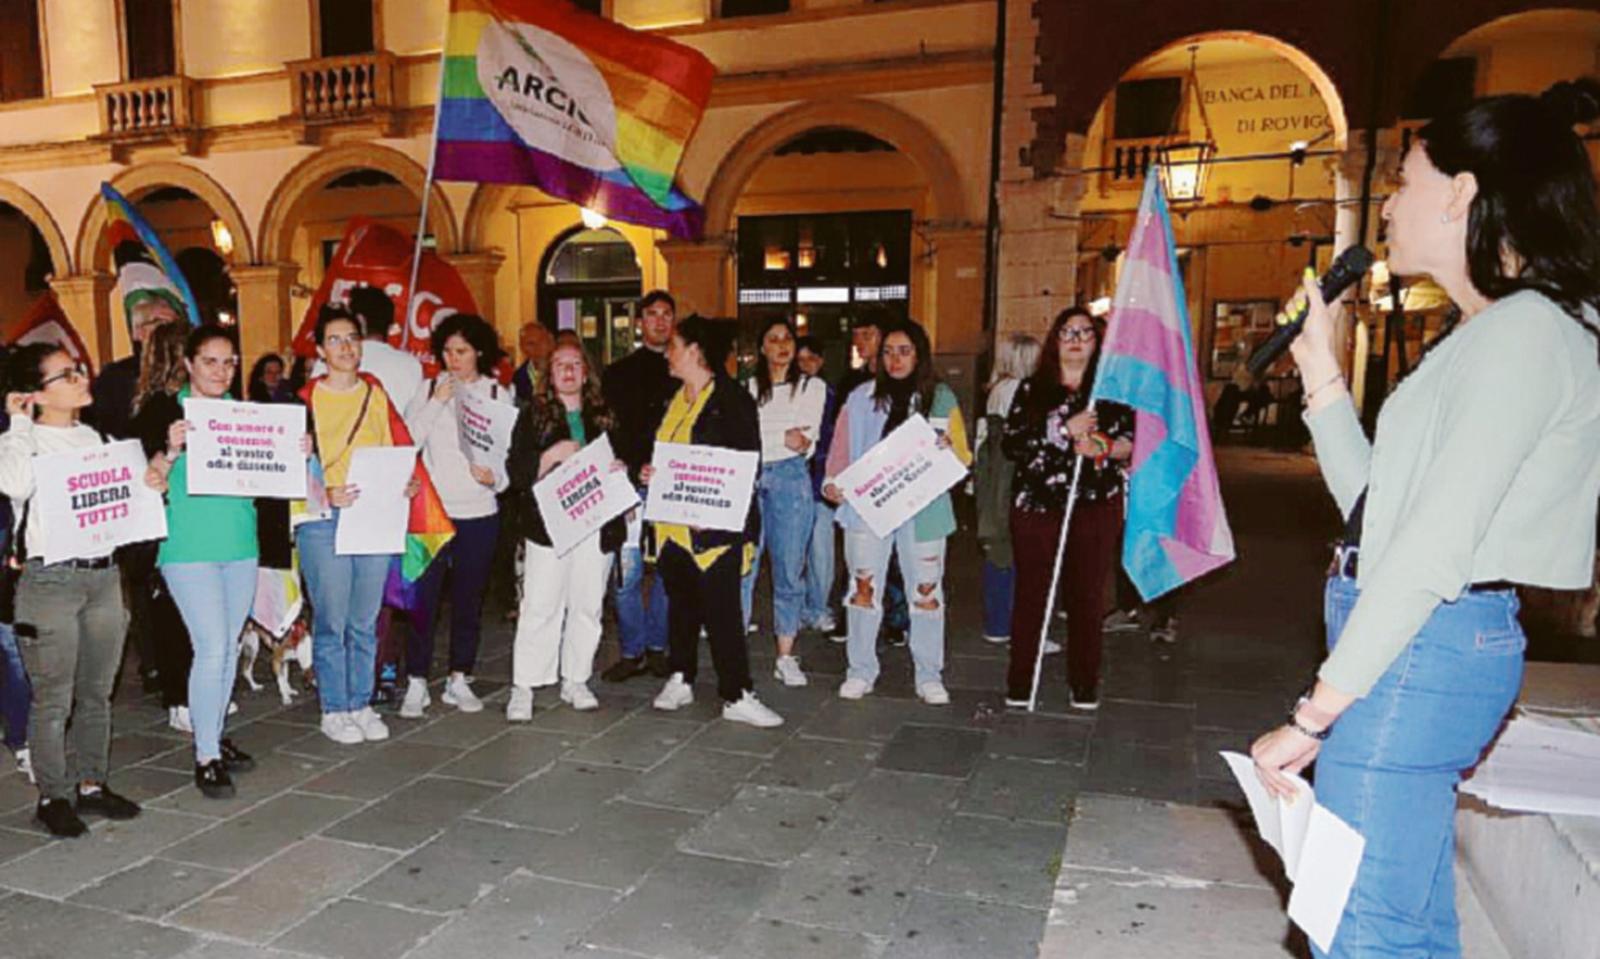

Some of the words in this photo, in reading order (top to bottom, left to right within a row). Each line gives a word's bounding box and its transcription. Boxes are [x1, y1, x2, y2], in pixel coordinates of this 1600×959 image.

[1203, 87, 1265, 104] BANCA
[1270, 84, 1299, 99] DEL
[1236, 119, 1256, 133] DI
[208, 419, 232, 431] Con
[235, 423, 274, 433] amore
[235, 449, 274, 460] vostro
[236, 460, 287, 473] dissento
[66, 466, 132, 493] SCUOLA
[556, 464, 599, 500] SCUOLA
[70, 485, 131, 511] LIBERA
[561, 476, 602, 511] LIBERA
